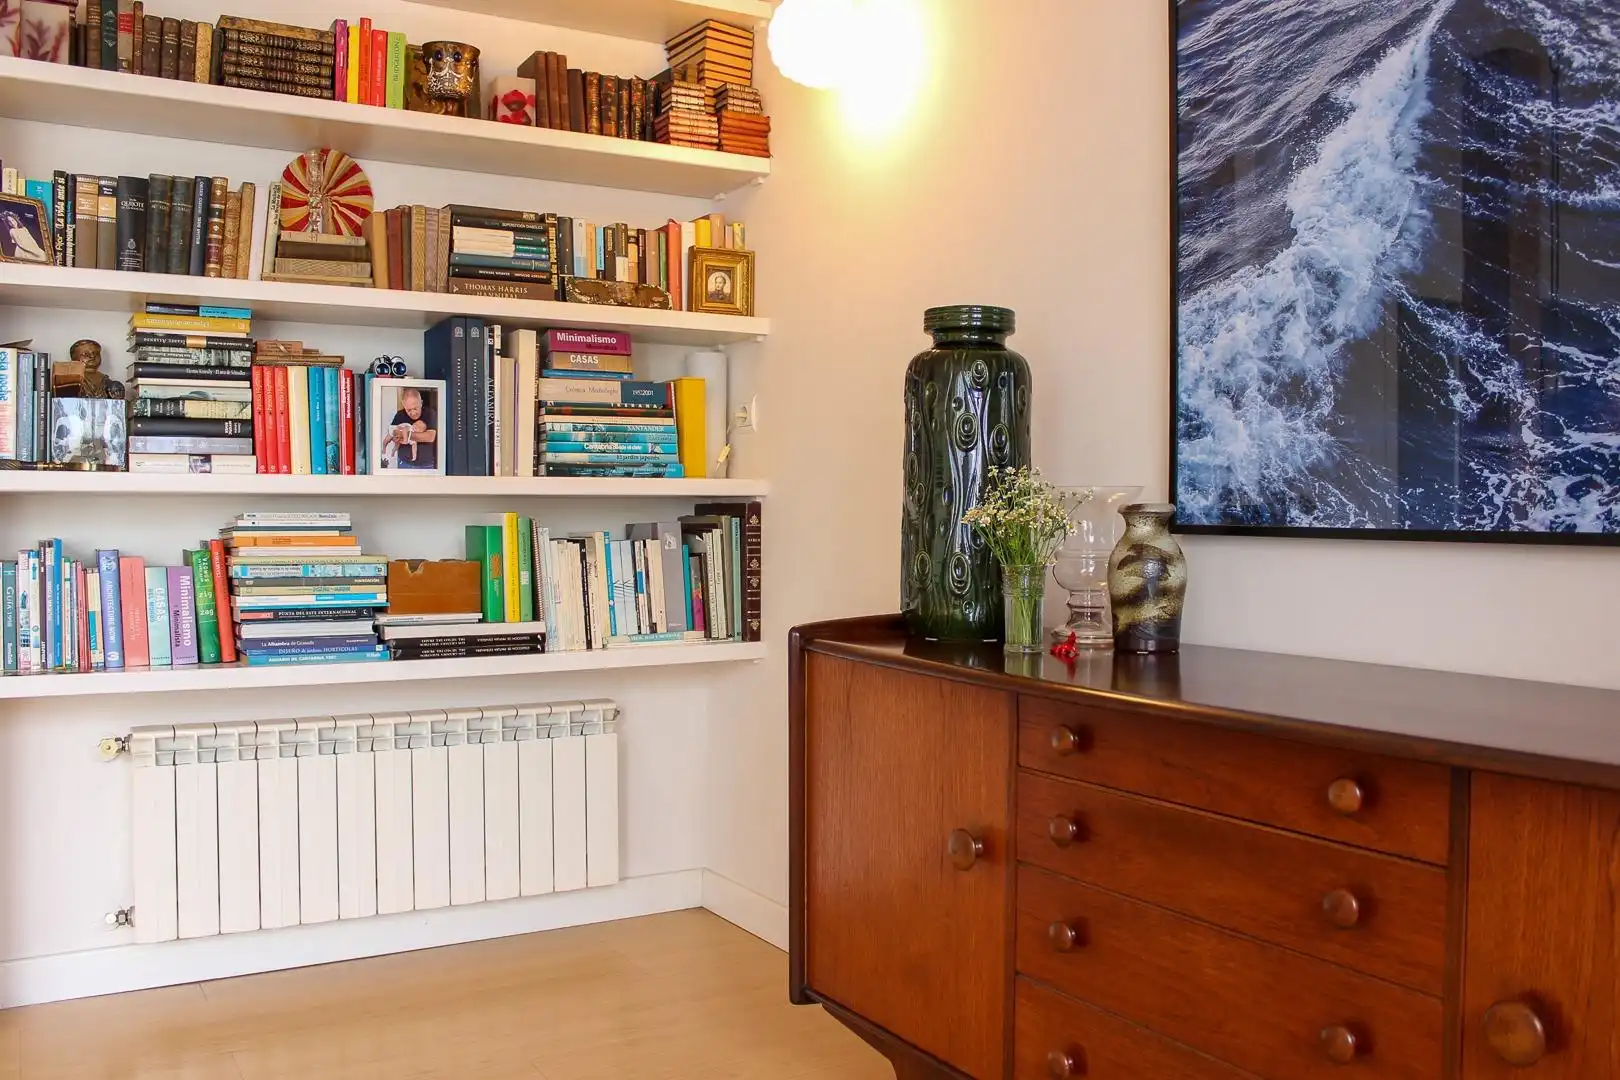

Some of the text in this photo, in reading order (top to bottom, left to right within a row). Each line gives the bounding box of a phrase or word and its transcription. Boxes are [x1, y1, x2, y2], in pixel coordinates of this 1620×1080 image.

[464, 283, 528, 294] THOMAS HARRIS
[556, 332, 617, 344] Minimalismo
[570, 354, 599, 364] CASAS
[487, 377, 495, 426] ALTAMIRA
[105, 580, 115, 626] ARCHITECTURE
[154, 588, 166, 622] CASAS
[199, 590, 213, 600] zig
[179, 575, 193, 647] Minimalismo
[200, 608, 215, 617] zag
[172, 609, 182, 648] Minimalista
